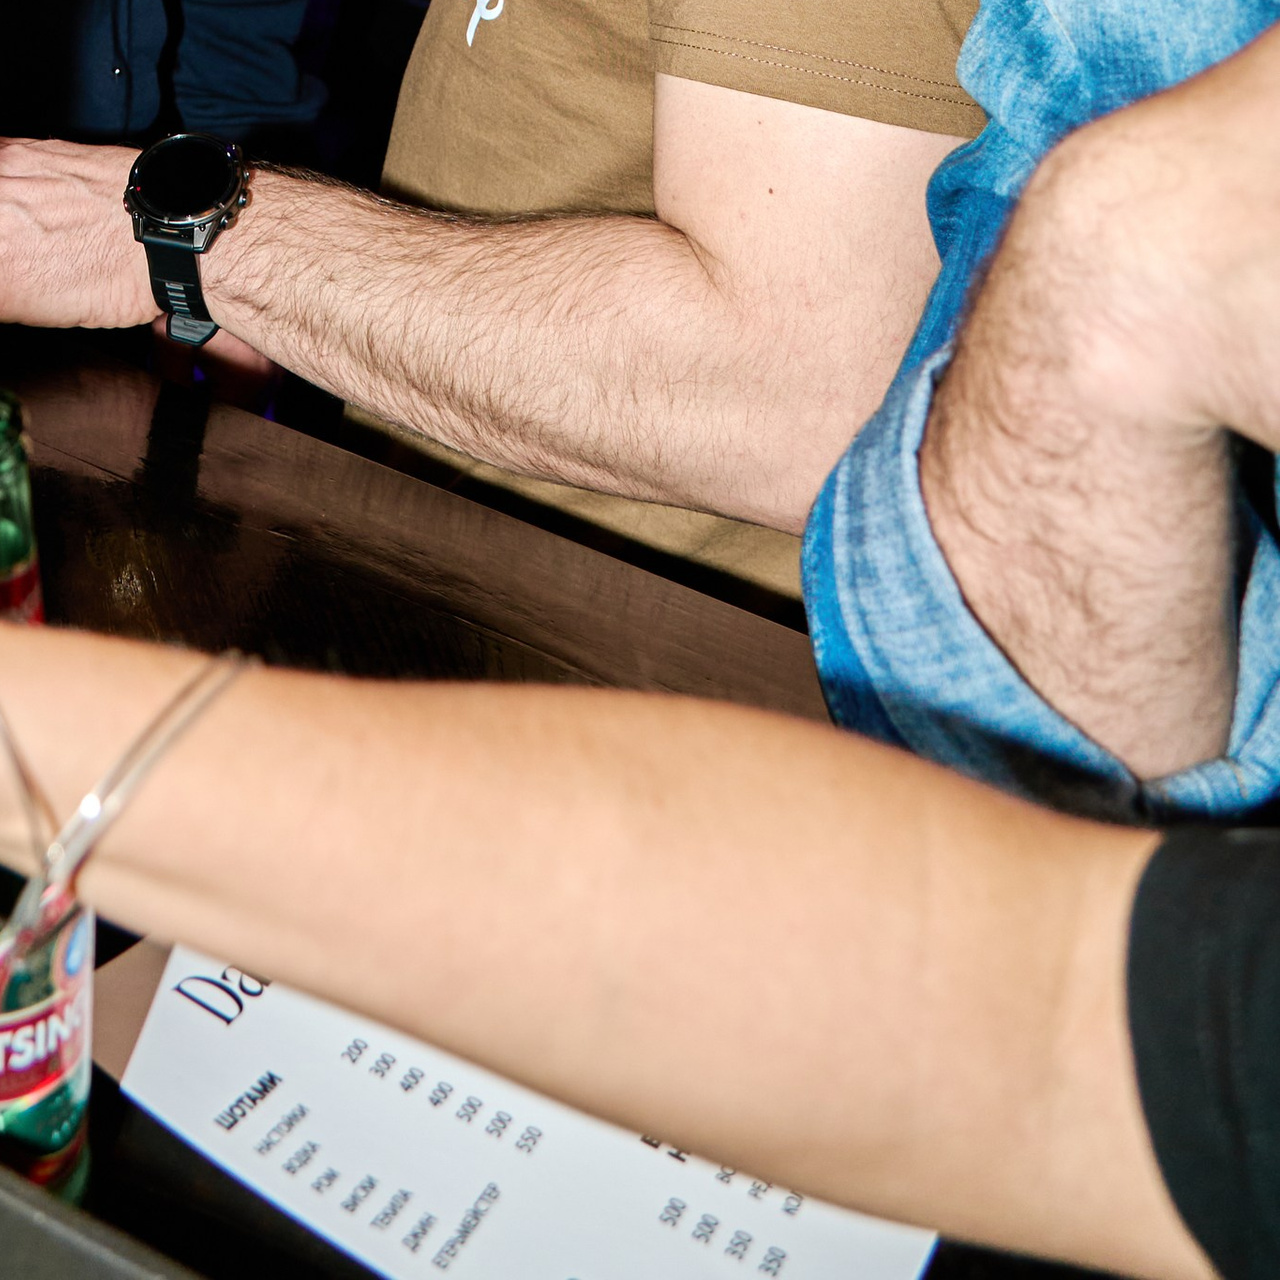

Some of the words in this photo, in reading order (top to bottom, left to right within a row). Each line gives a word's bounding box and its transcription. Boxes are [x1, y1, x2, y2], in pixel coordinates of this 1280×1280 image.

[340, 1038, 369, 1064] 200
[369, 1052, 396, 1078] 300
[399, 1066, 425, 1092] 400
[214, 1069, 283, 1132] ШОТАМИ
[427, 1081, 454, 1107] 400
[455, 1095, 483, 1123] 500
[485, 1110, 512, 1138] 500
[515, 1125, 543, 1153] 550
[658, 1197, 687, 1227] 500
[691, 1213, 719, 1244] 500
[724, 1230, 753, 1260] 350
[758, 1246, 787, 1277] 350
